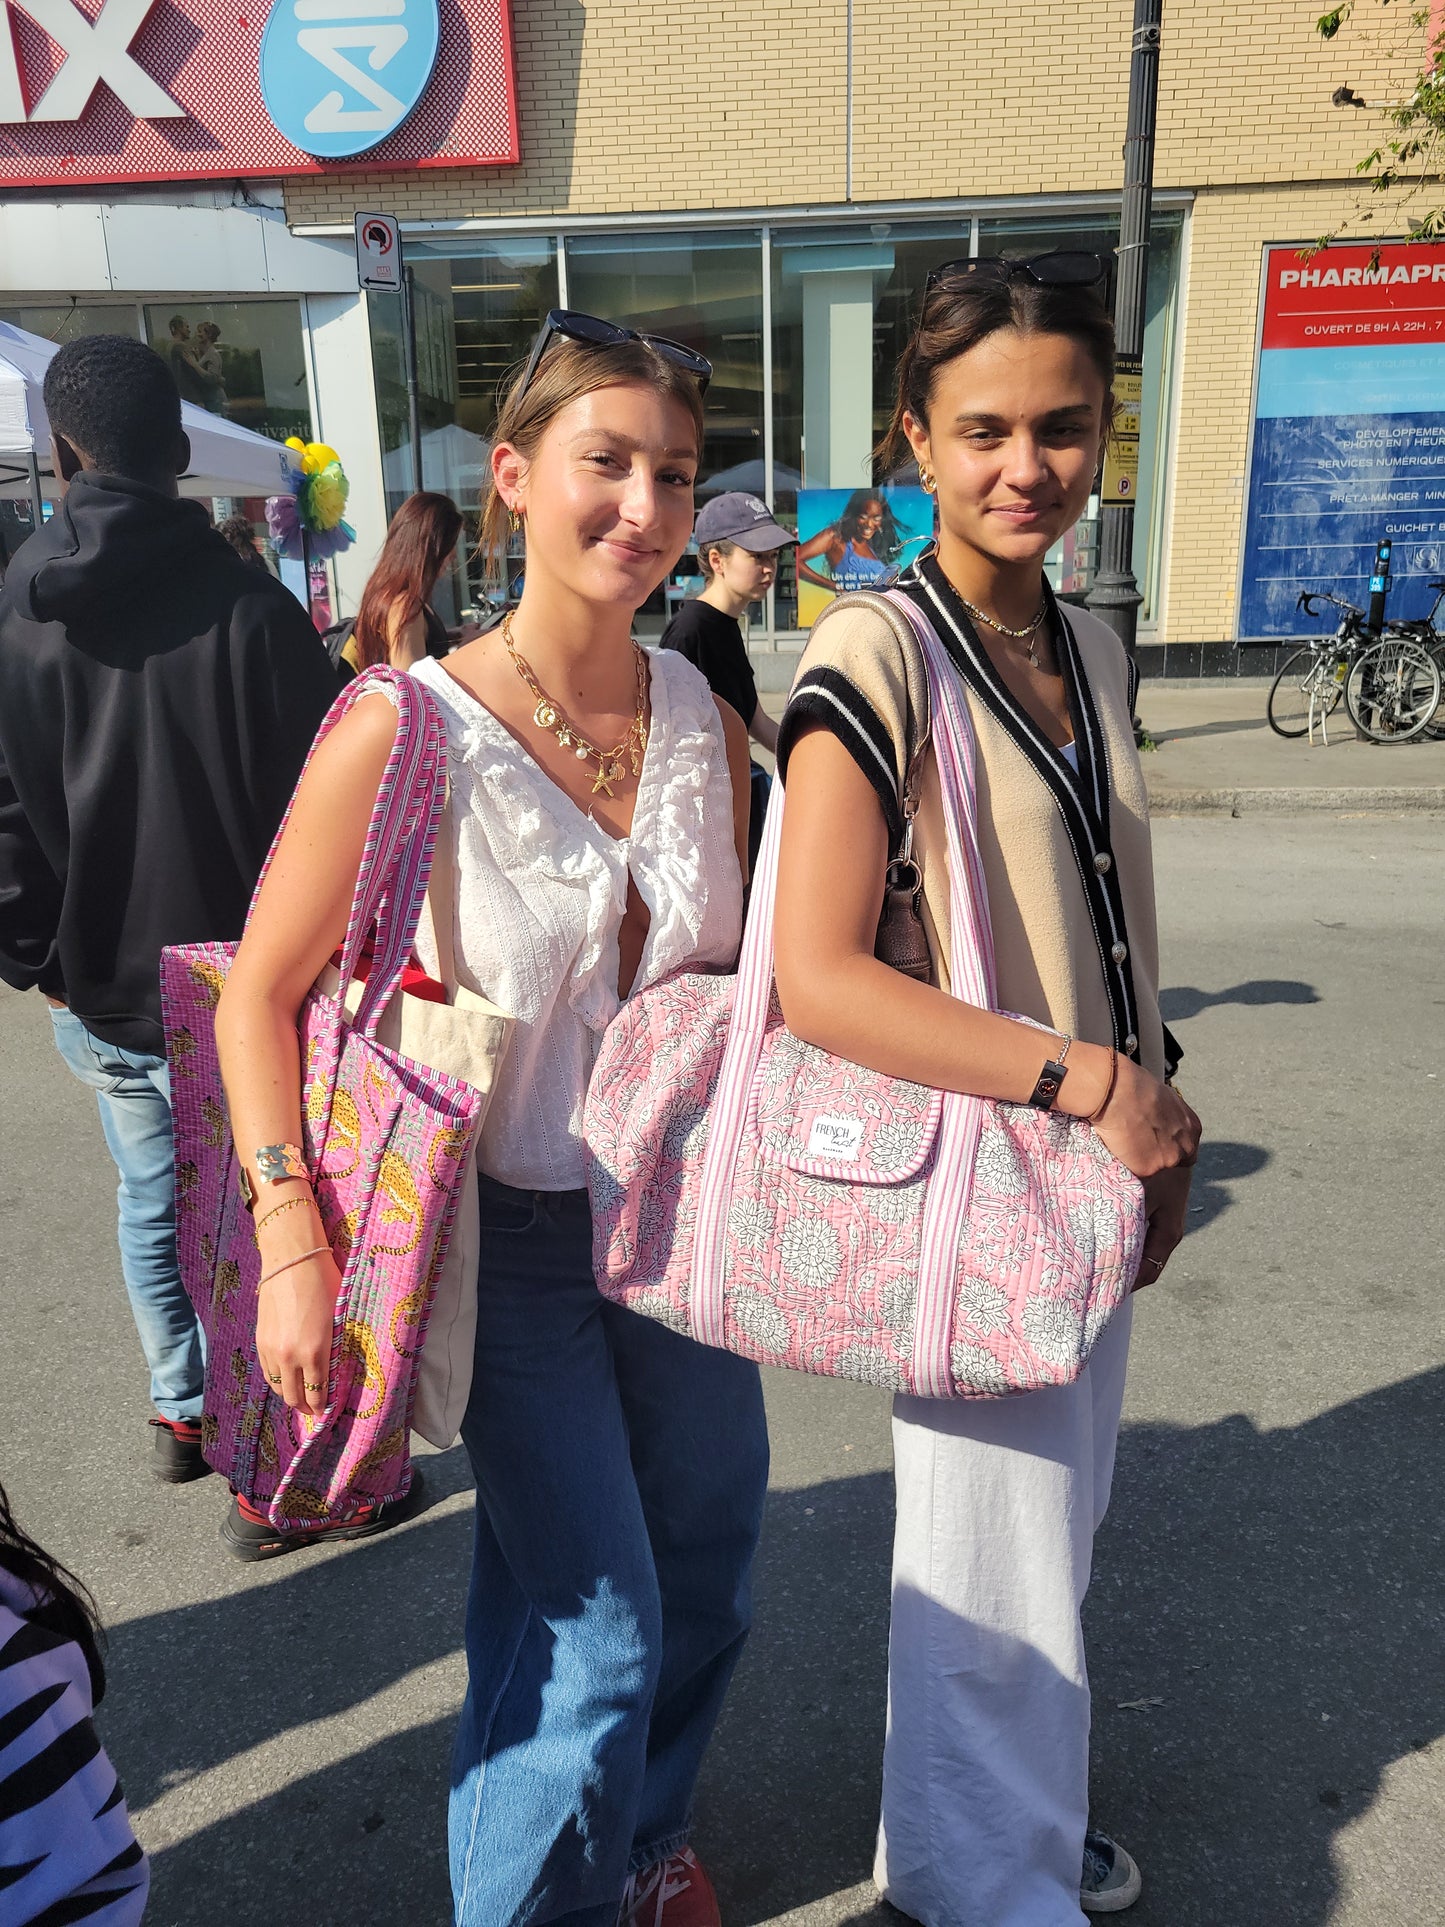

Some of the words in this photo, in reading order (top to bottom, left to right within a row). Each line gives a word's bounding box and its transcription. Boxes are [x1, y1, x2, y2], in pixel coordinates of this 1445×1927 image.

[1279, 264, 1445, 289] PHARMAPR
[1304, 324, 1353, 336] OUVERT
[1355, 323, 1371, 334] DE
[1373, 322, 1389, 333] 9H
[1391, 321, 1401, 332] À
[1403, 321, 1426, 331] 22H
[1435, 320, 1443, 330] 7
[1355, 427, 1445, 439] DÉVELOPPEMEN
[1343, 440, 1383, 449] PHOTO
[1386, 439, 1402, 448] EN
[1406, 439, 1410, 447] 1
[1318, 459, 1373, 469] SERVICES
[1385, 523, 1436, 533] GUICHET
[831, 572, 843, 581] Un
[844, 572, 857, 580] été
[815, 1122, 850, 1138] FRENCH
